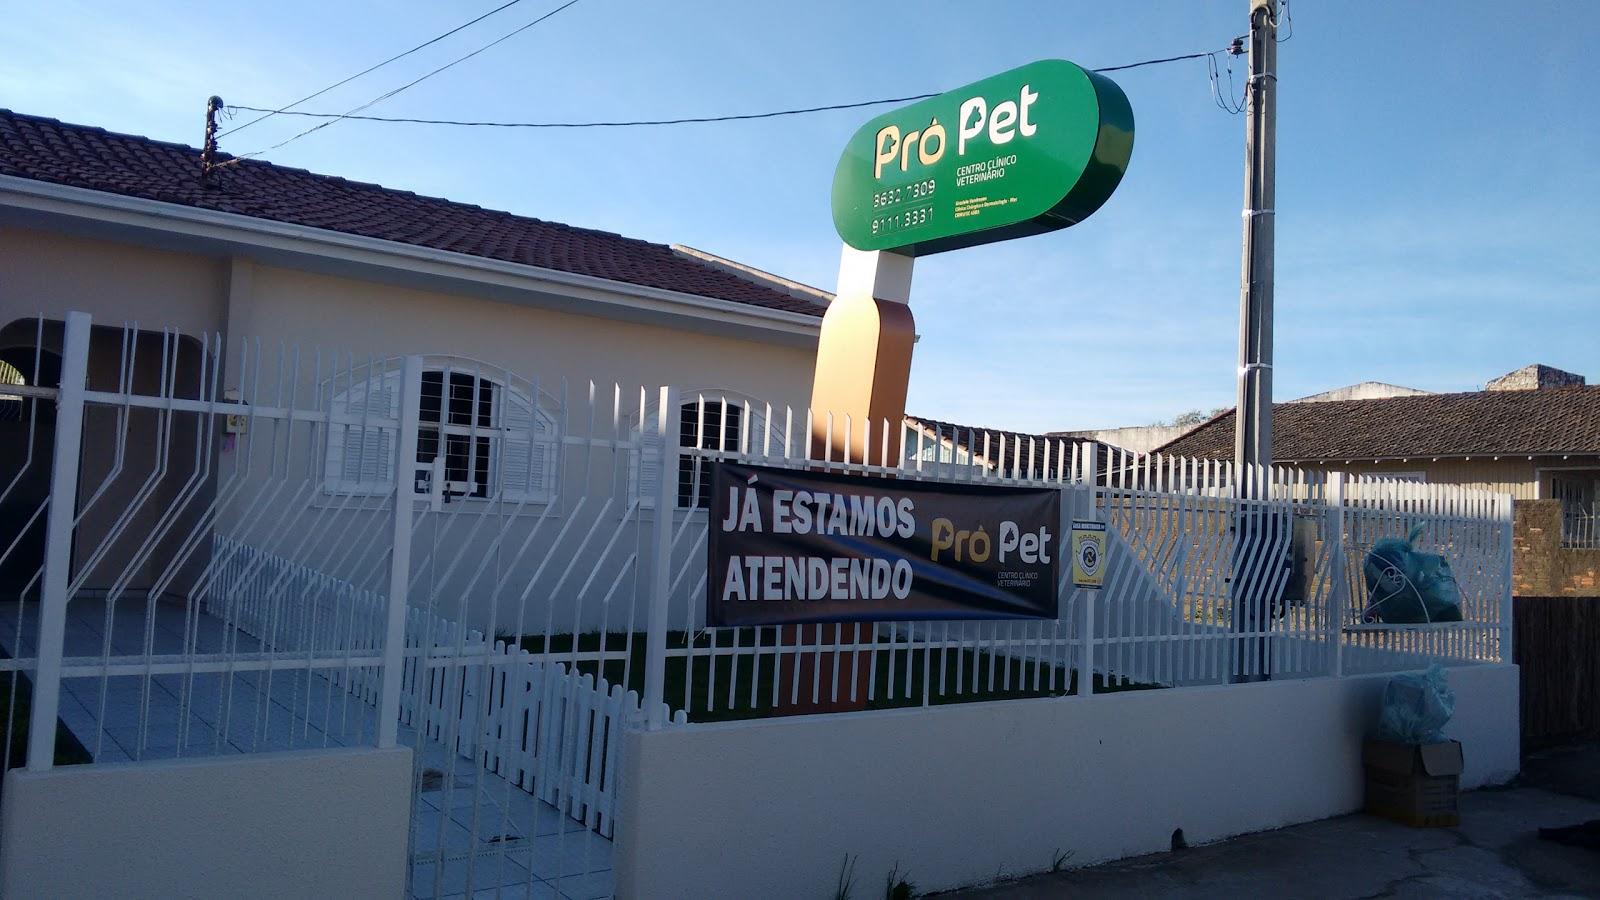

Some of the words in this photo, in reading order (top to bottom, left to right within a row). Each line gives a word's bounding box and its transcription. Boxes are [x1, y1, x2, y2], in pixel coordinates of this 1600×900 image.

[958, 84, 1039, 156] Pet
[956, 168, 1005, 187] VETERINÁRIO
[957, 162, 986, 177] CENTRO
[987, 154, 1017, 170] CLÍNICO
[872, 207, 933, 234] 9111.3331
[722, 473, 763, 533] JÁ
[772, 490, 916, 539] ESTAMOS
[999, 520, 1051, 565] Pet
[722, 555, 914, 602] ATENDENDO
[998, 571, 1018, 580] CENTRO
